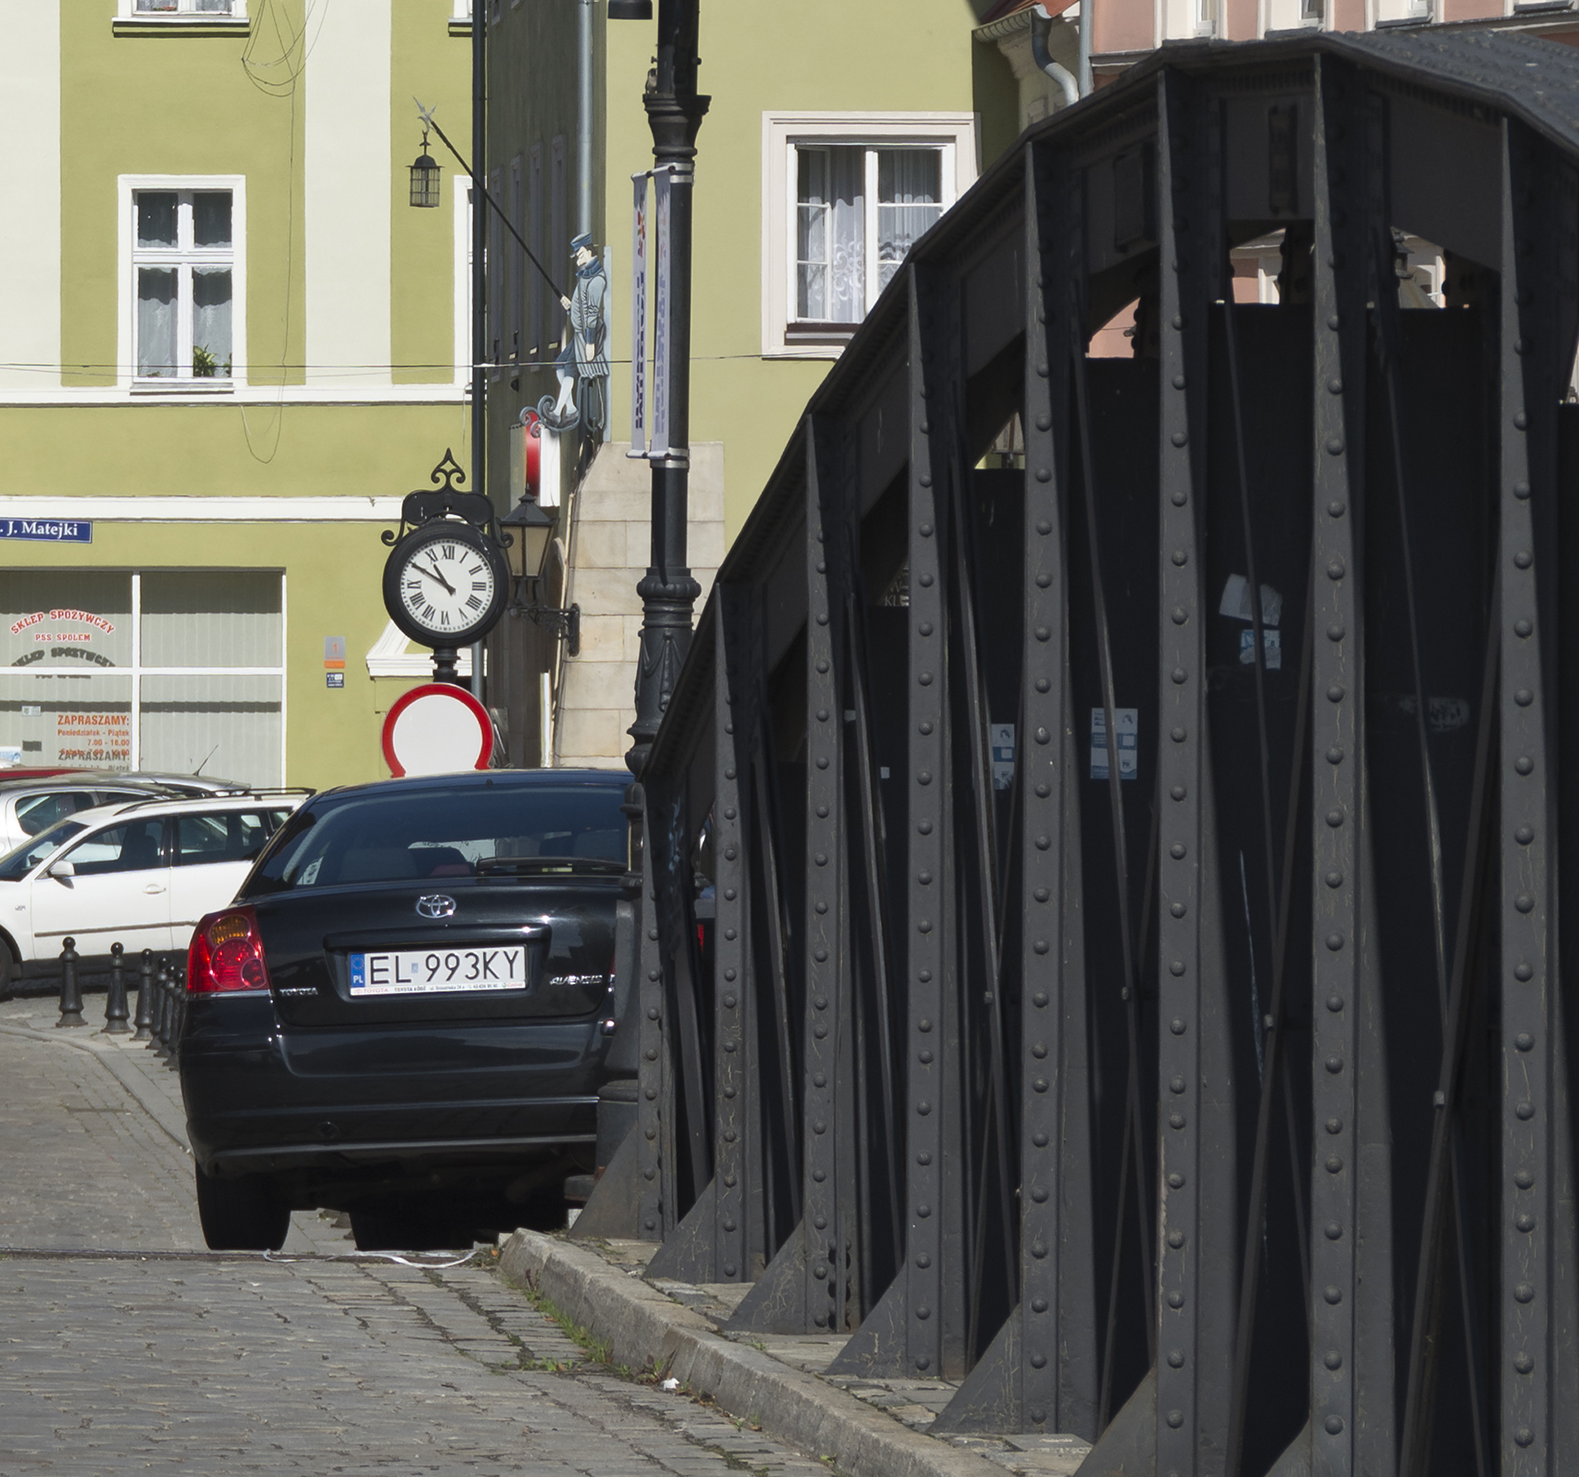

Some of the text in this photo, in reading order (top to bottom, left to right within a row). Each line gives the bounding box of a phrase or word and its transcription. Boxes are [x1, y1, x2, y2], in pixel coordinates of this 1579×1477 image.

[6, 521, 17, 536] J.
[21, 520, 78, 540] Matejki
[11, 612, 45, 634] SKLEP
[57, 715, 130, 726] ZAPRASZAMY:
[370, 950, 519, 985] EL 993KY
[353, 975, 364, 984] PL
